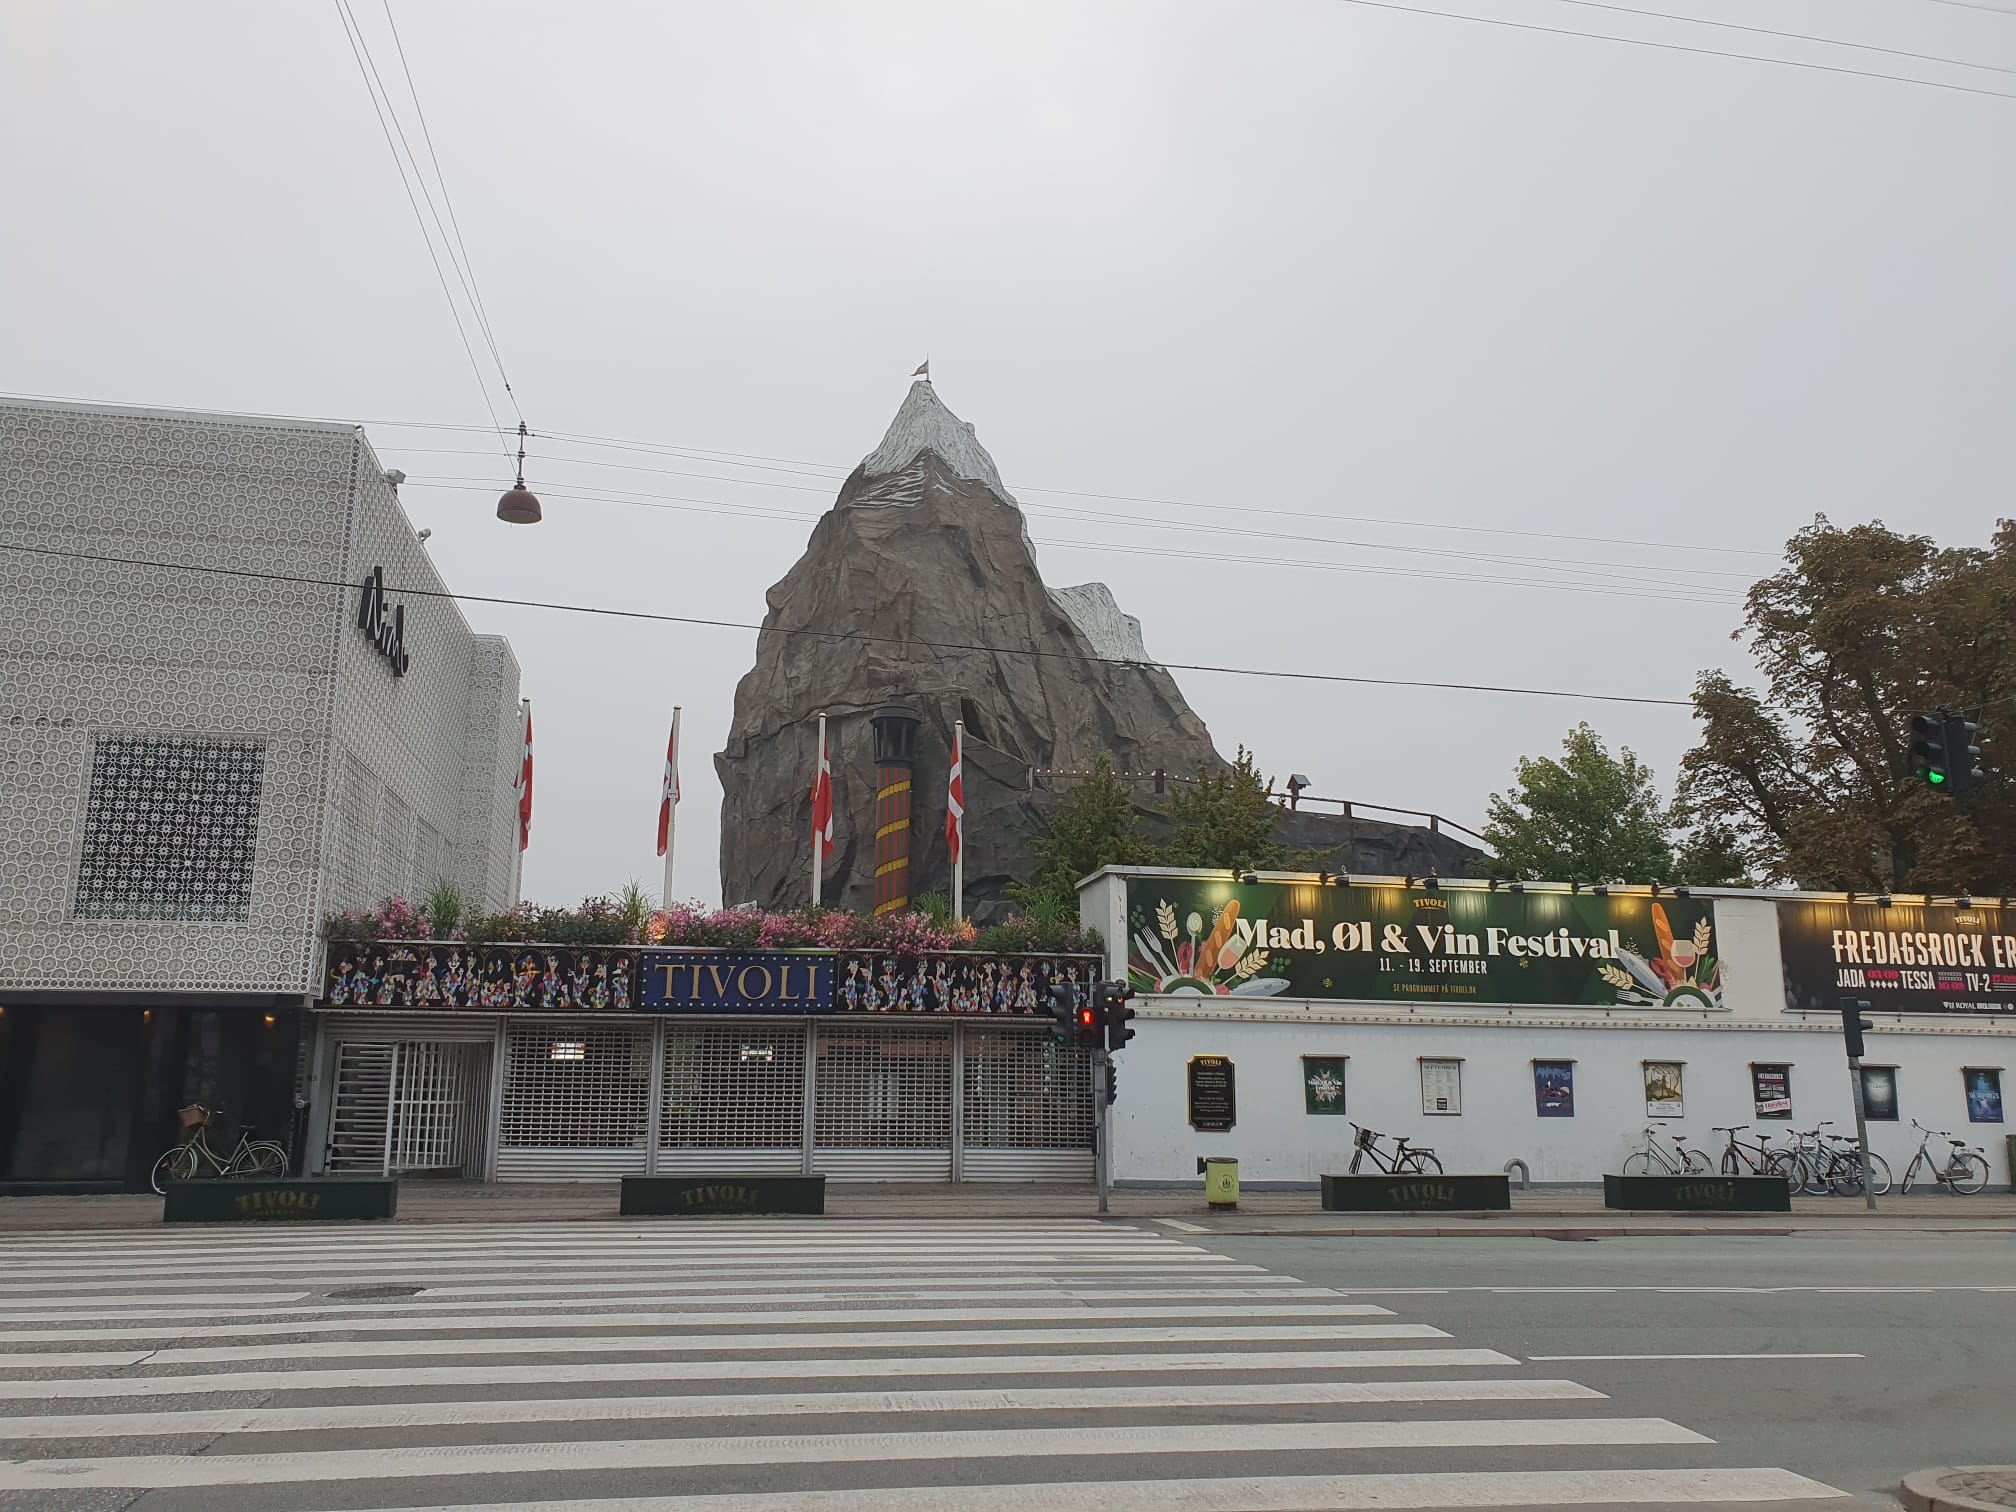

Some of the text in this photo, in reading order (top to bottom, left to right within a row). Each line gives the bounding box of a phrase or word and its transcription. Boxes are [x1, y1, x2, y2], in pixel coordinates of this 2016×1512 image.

[1413, 898, 1448, 909] TIVOLI
[1953, 915, 1980, 924] TIVOLI
[1235, 918, 1620, 959] Mad, Øl & Vin Festival
[1831, 929, 2016, 968] FREDAGSROCK ER
[1379, 957, 1395, 972] 11.
[1408, 958, 1425, 973] 19.
[1429, 958, 1488, 974] SEPTEMBER
[654, 963, 819, 1000] TIVOLI
[1401, 983, 1440, 993] PROGRAMMET
[1441, 983, 1449, 993] PÅ
[1836, 968, 1867, 988] JADA
[1900, 970, 1936, 990] TESSA
[1965, 973, 1992, 992] TV-2
[235, 1190, 320, 1210] TIVOLI
[681, 1185, 759, 1205] TIVOLI
[1388, 1183, 1455, 1202] TIVOLI
